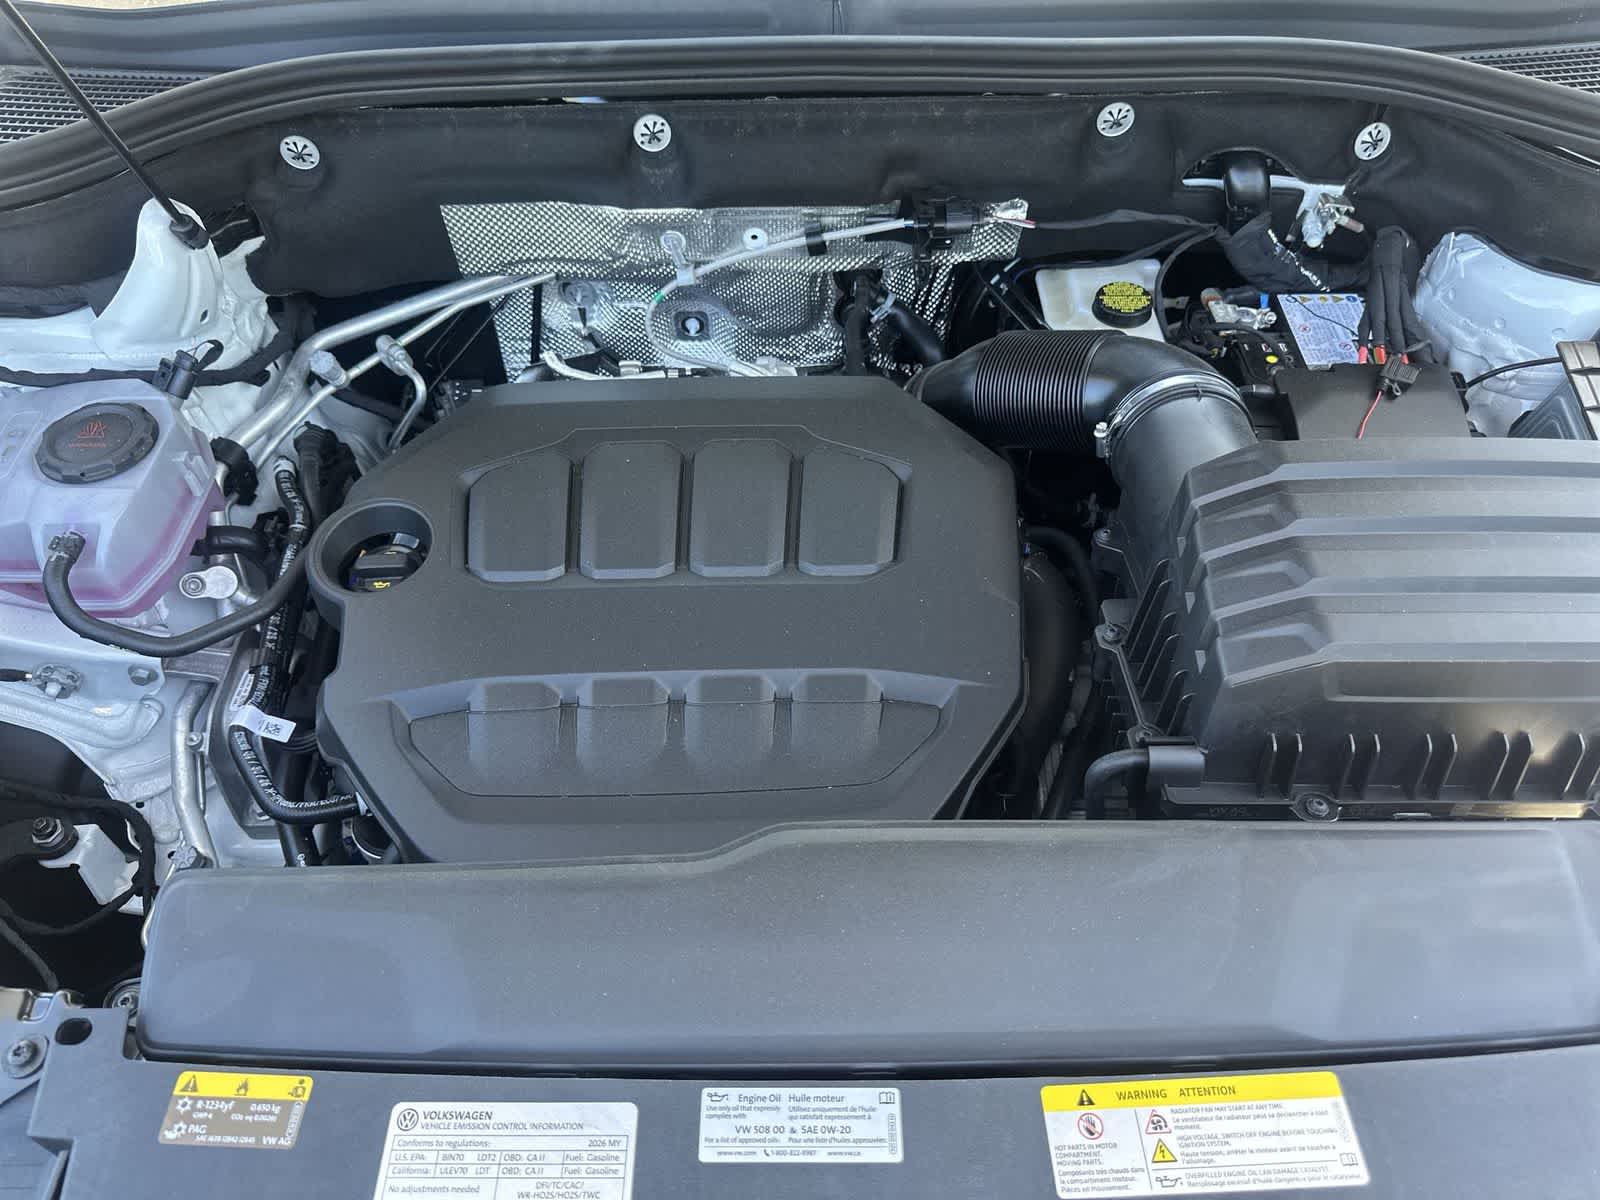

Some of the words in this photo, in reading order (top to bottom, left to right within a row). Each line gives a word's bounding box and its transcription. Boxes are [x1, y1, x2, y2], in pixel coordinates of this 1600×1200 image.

[1116, 1089, 1167, 1100] WARNING
[1180, 1086, 1236, 1097] ATTENTION
[739, 1094, 767, 1104] Engine
[769, 1094, 781, 1102] Oil
[788, 1094, 811, 1102] Huile
[196, 1100, 235, 1112] R-1234yf
[271, 1104, 281, 1114] kg
[422, 1111, 492, 1120] VOLKSWAGEN
[188, 1124, 207, 1133] PAG
[420, 1122, 451, 1130] VEHICLE
[452, 1122, 490, 1130] EMISSION
[529, 1122, 584, 1130] INFORMATION
[735, 1125, 752, 1134] VW
[753, 1125, 770, 1134] 508
[772, 1125, 785, 1134] 00
[801, 1126, 819, 1134] SAE
[820, 1126, 851, 1134] 0W-20
[262, 1136, 277, 1144] VW
[278, 1136, 291, 1145] AG
[445, 1139, 489, 1149] regulations:
[1059, 1169, 1095, 1178] Composants
[1067, 1176, 1110, 1185] compartiment
[401, 1185, 449, 1195] adjustments
